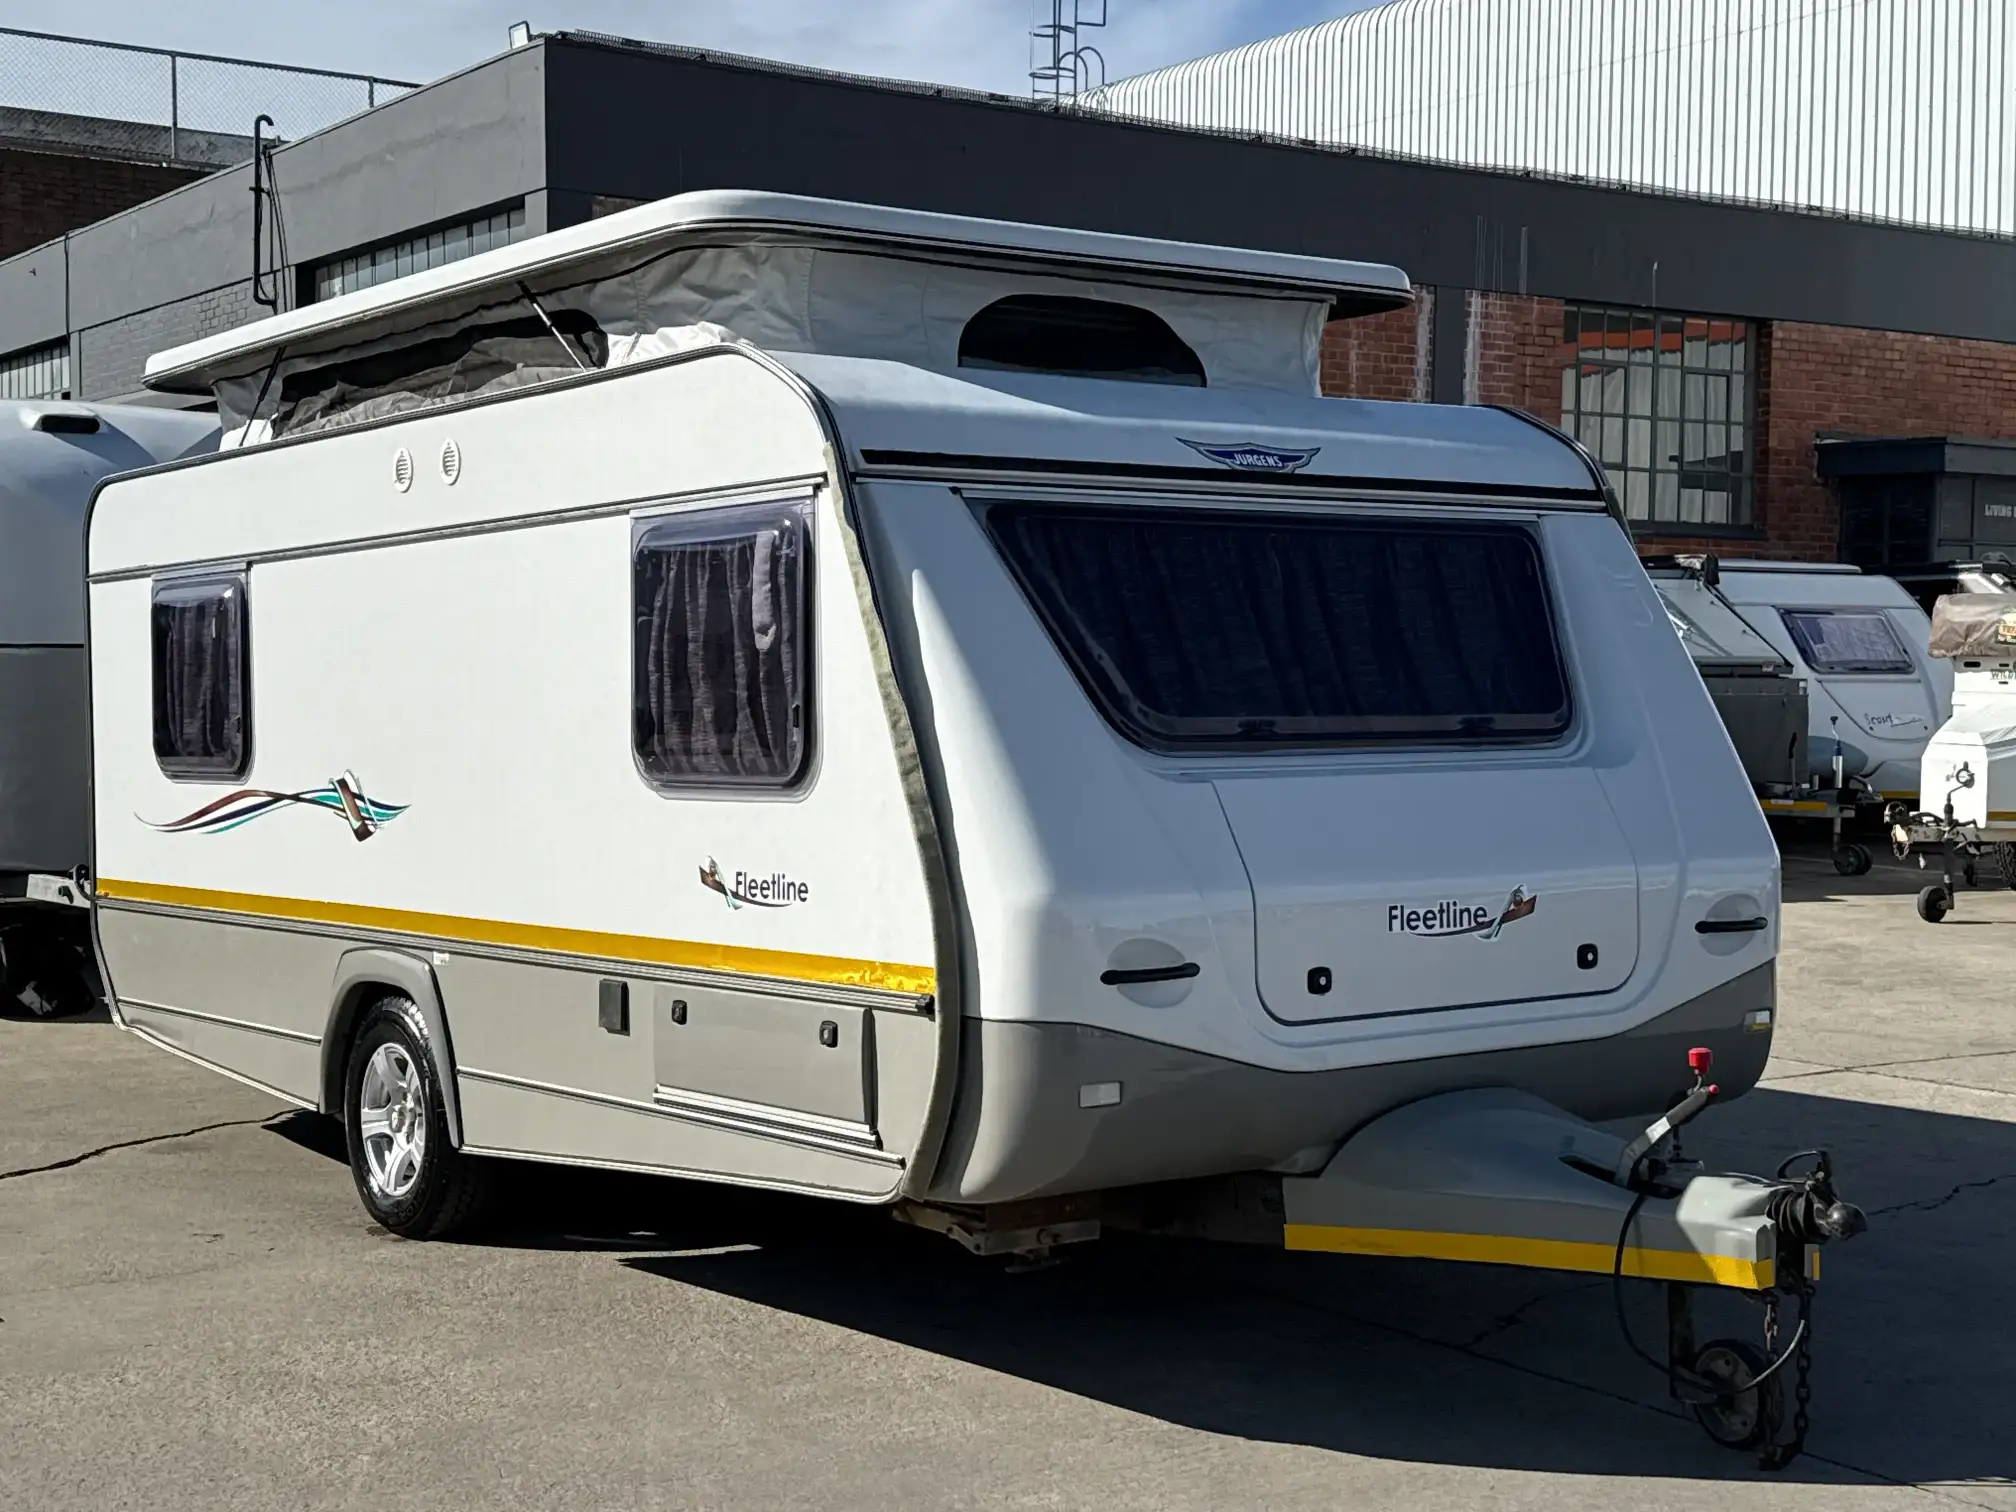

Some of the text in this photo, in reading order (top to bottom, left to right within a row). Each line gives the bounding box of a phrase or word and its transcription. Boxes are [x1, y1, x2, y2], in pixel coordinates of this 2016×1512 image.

[1232, 452, 1283, 467] JURGENS
[735, 871, 809, 902] Fleetline
[1388, 900, 1488, 932] Fleetline
